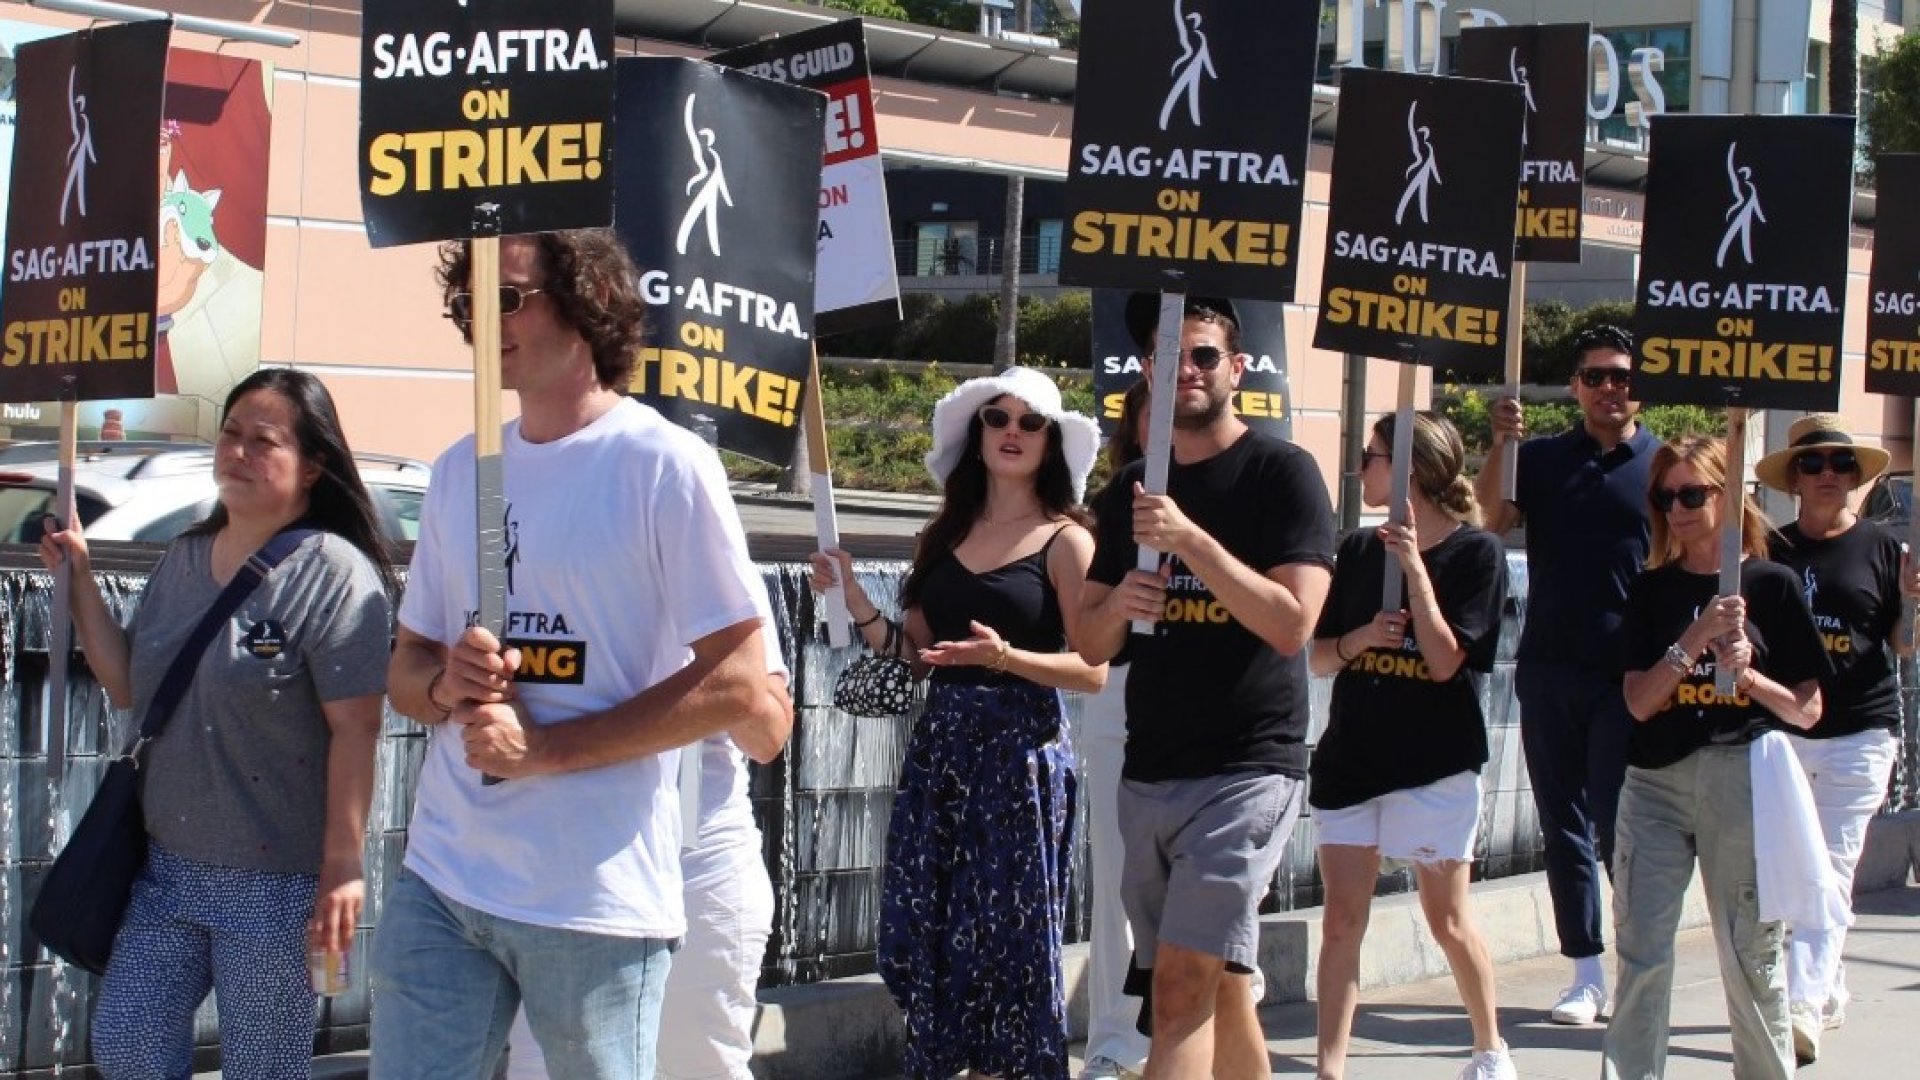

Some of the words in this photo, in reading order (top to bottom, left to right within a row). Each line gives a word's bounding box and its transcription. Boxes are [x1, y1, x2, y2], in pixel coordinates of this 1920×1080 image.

[790, 42, 854, 80] GUILD
[462, 88, 509, 121] ON
[369, 122, 602, 196] STRIKE!
[1157, 188, 1200, 212] ON
[1071, 211, 1290, 267] STRIKE!
[1515, 207, 1577, 238] IKE!
[58, 287, 86, 312] ON
[1393, 274, 1427, 296] ON
[1326, 287, 1499, 345] STRIKE!
[1716, 317, 1754, 337] ON
[1, 312, 149, 367] STRIKE!
[680, 320, 724, 353] ON
[1640, 337, 1833, 382] STRIKE!
[627, 347, 801, 427] TRIKE!
[3, 403, 40, 420] hulu
[1164, 598, 1230, 624] ONG
